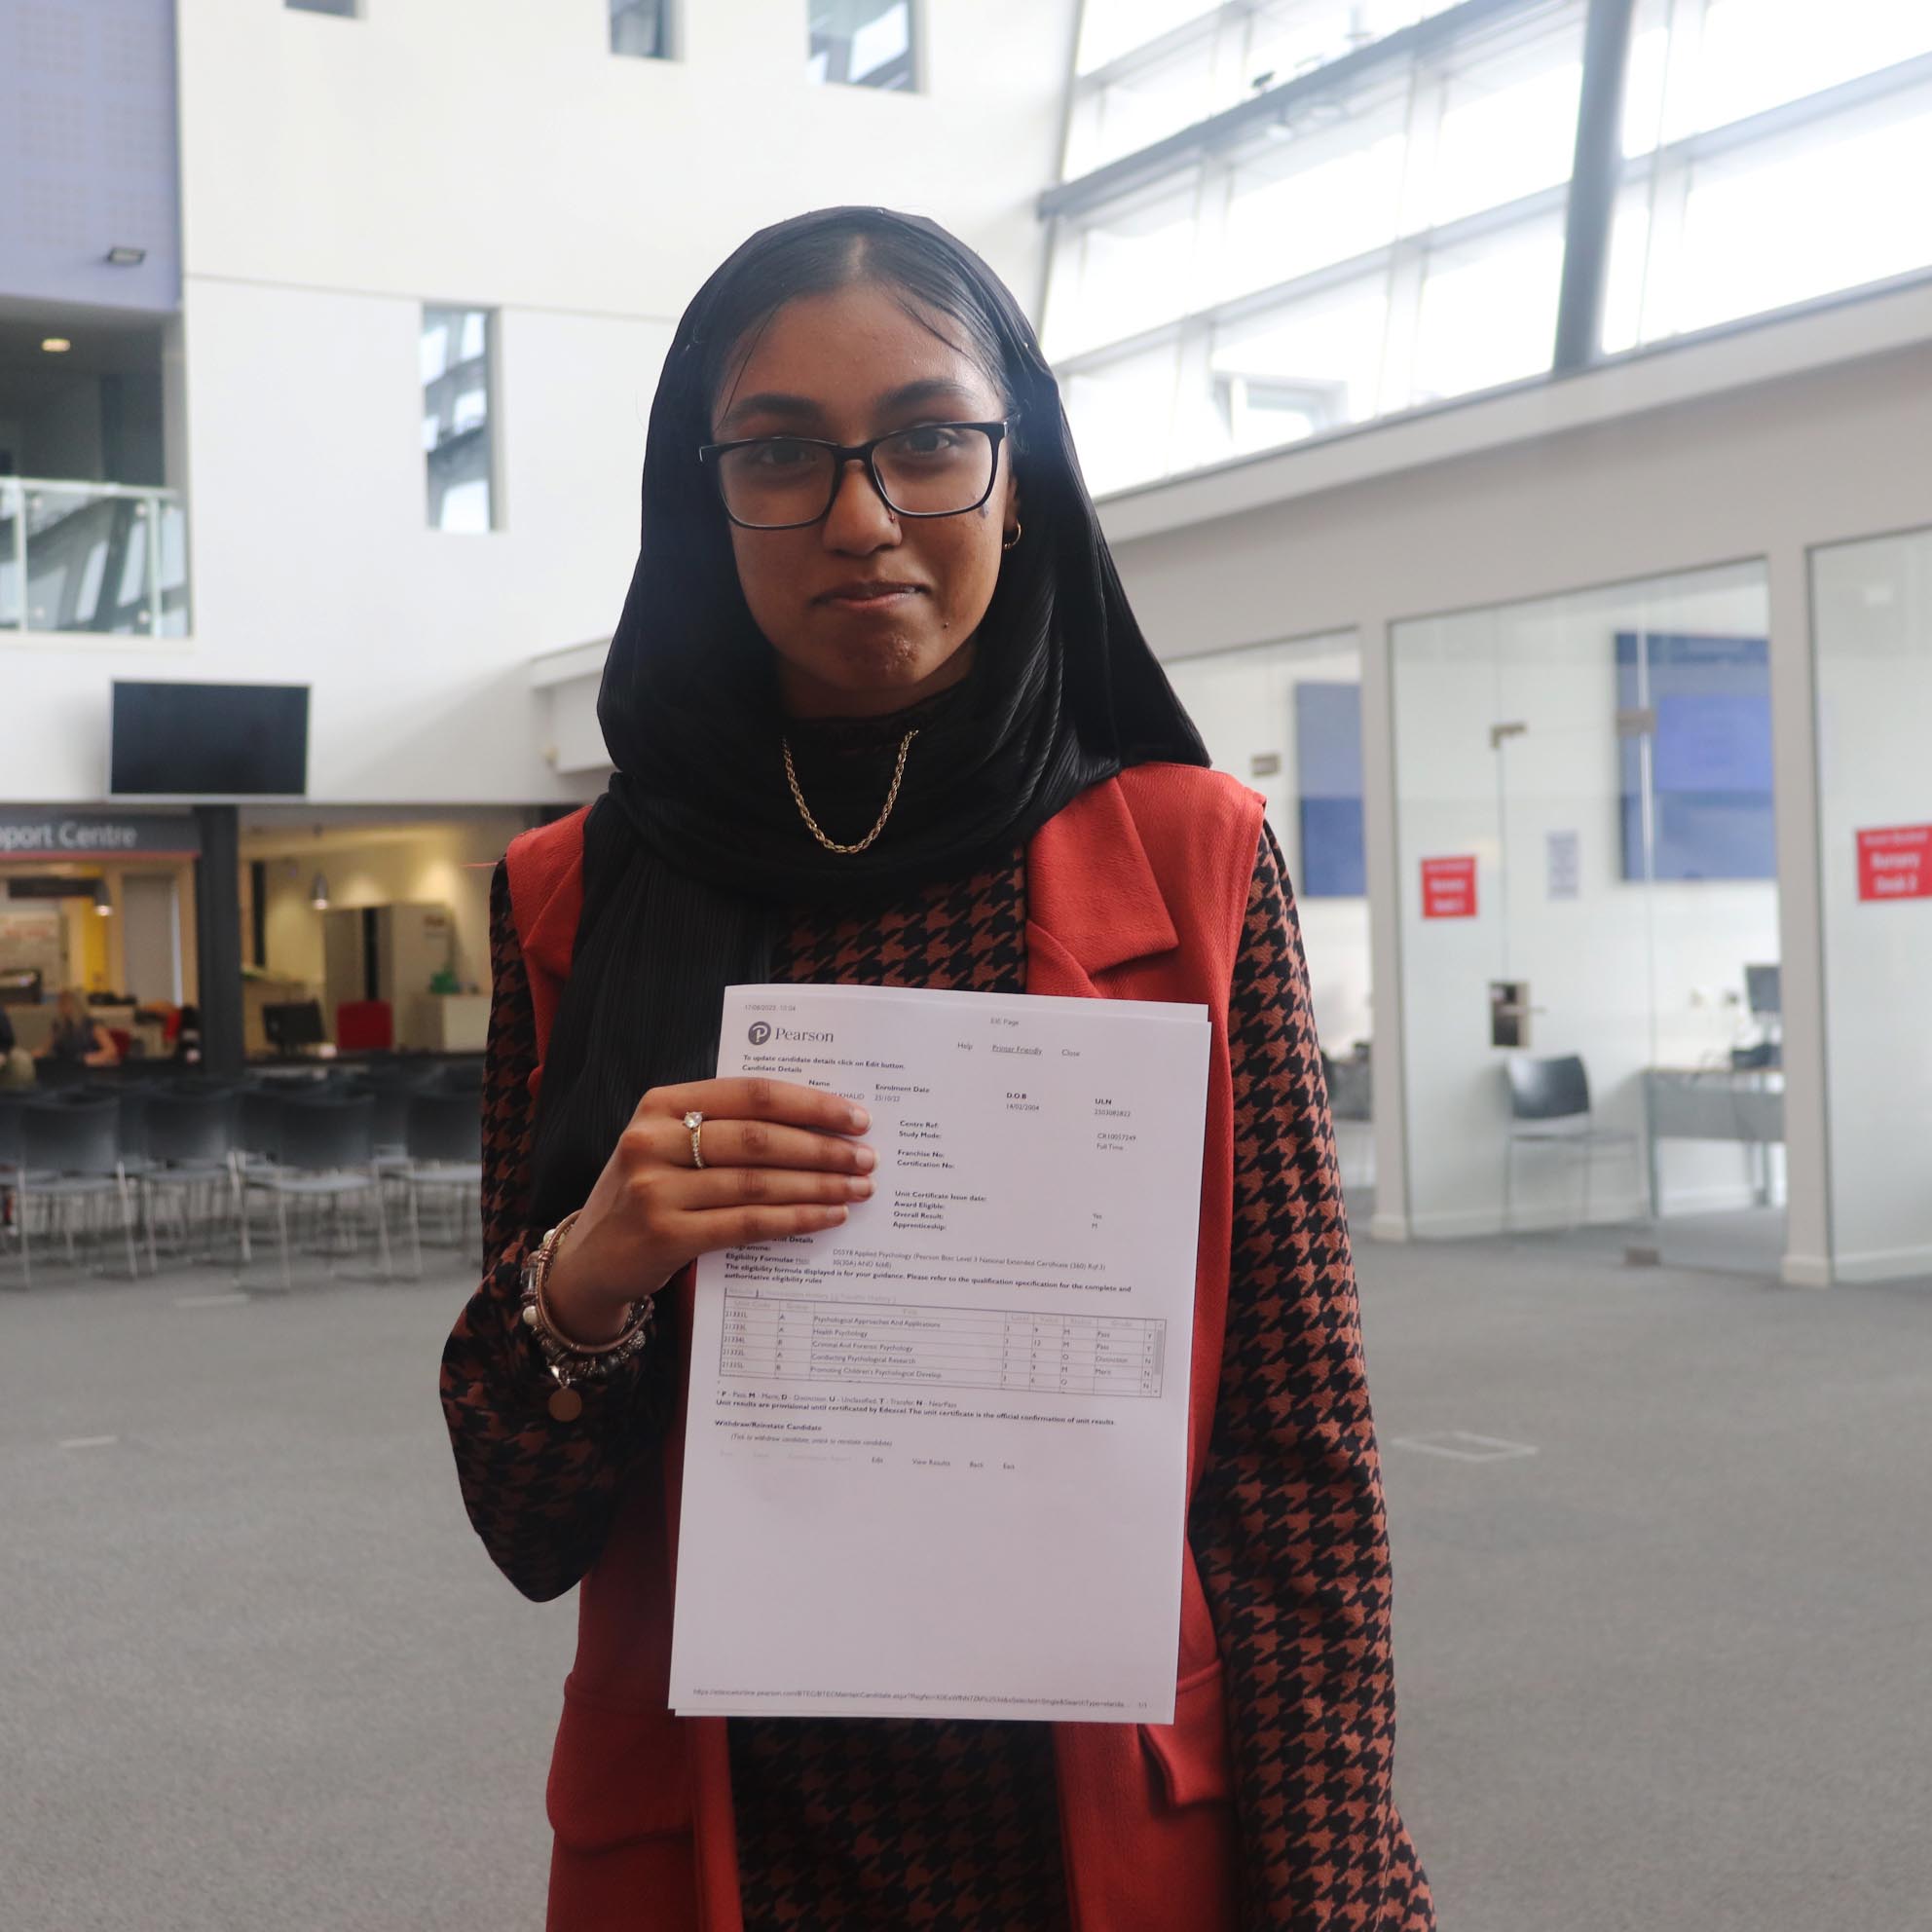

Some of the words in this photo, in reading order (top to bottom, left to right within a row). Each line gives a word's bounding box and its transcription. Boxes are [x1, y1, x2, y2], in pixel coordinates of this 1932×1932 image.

[59, 820, 137, 848] Centre
[775, 1027, 834, 1043] Pearson
[957, 1042, 973, 1051] Help
[725, 1252, 758, 1262] Eligibility
[878, 1251, 911, 1260] Psychology
[740, 1264, 772, 1273] eligibility
[803, 1268, 835, 1277] displayed
[971, 1277, 1013, 1285] qualification
[1015, 1280, 1058, 1288] specification
[1085, 1283, 1117, 1292] complete
[771, 1275, 803, 1283] eligibility
[813, 1316, 853, 1324] Psychological
[879, 1344, 913, 1353] Psychology
[811, 1354, 845, 1362] Conducting
[810, 1366, 842, 1375] Promoting
[875, 1369, 914, 1378] Psychological
[771, 1402, 810, 1411] provisional
[1021, 1414, 1065, 1423] confirmation
[715, 1420, 784, 1430] Withdraw/Reinstate
